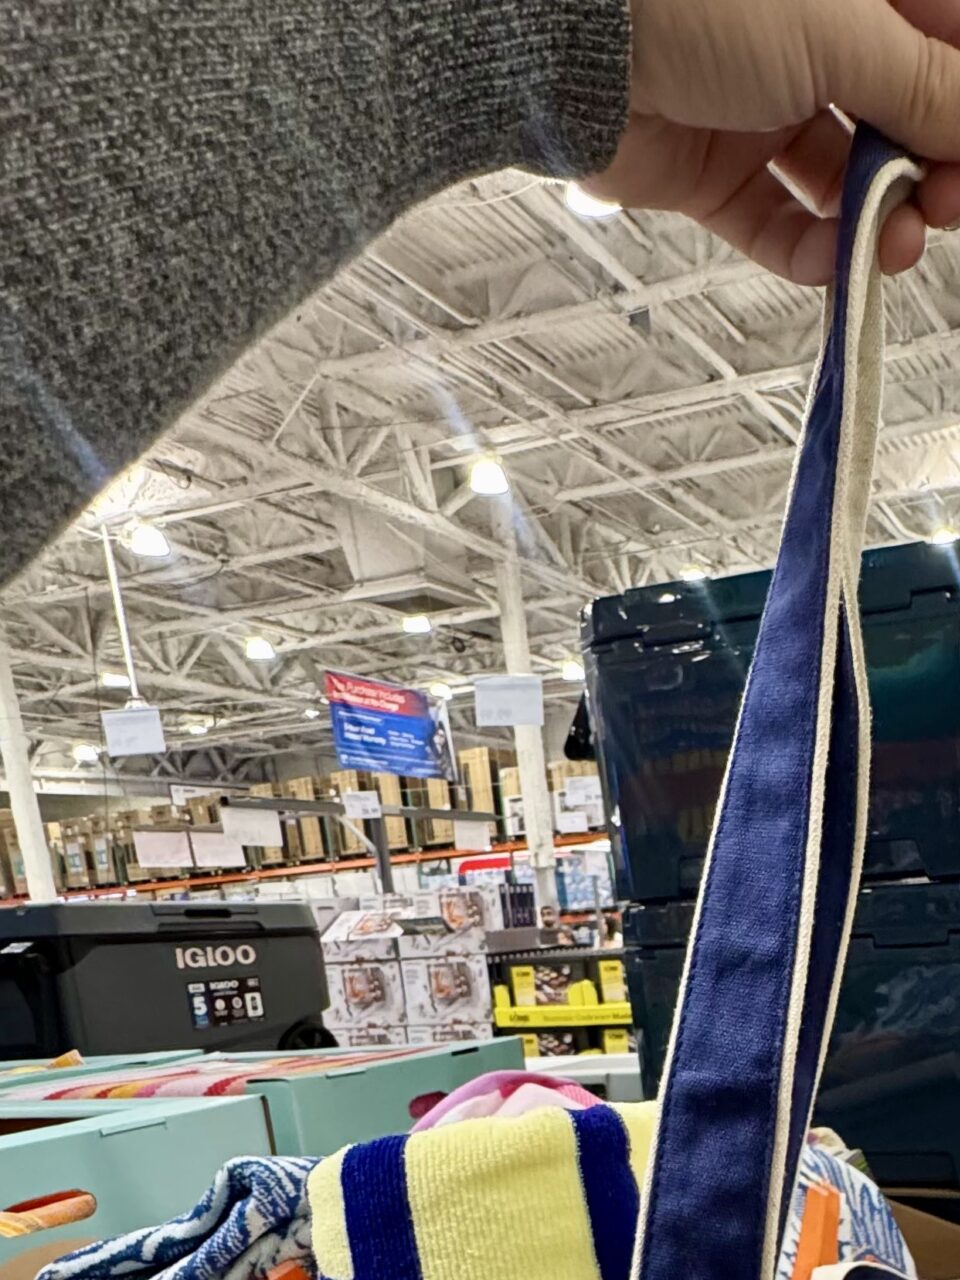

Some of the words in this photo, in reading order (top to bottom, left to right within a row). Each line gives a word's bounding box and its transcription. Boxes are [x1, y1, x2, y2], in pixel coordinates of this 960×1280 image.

[175, 944, 257, 969] IGLOO
[209, 980, 239, 990] IGLOO
[192, 996, 208, 1016] 5
